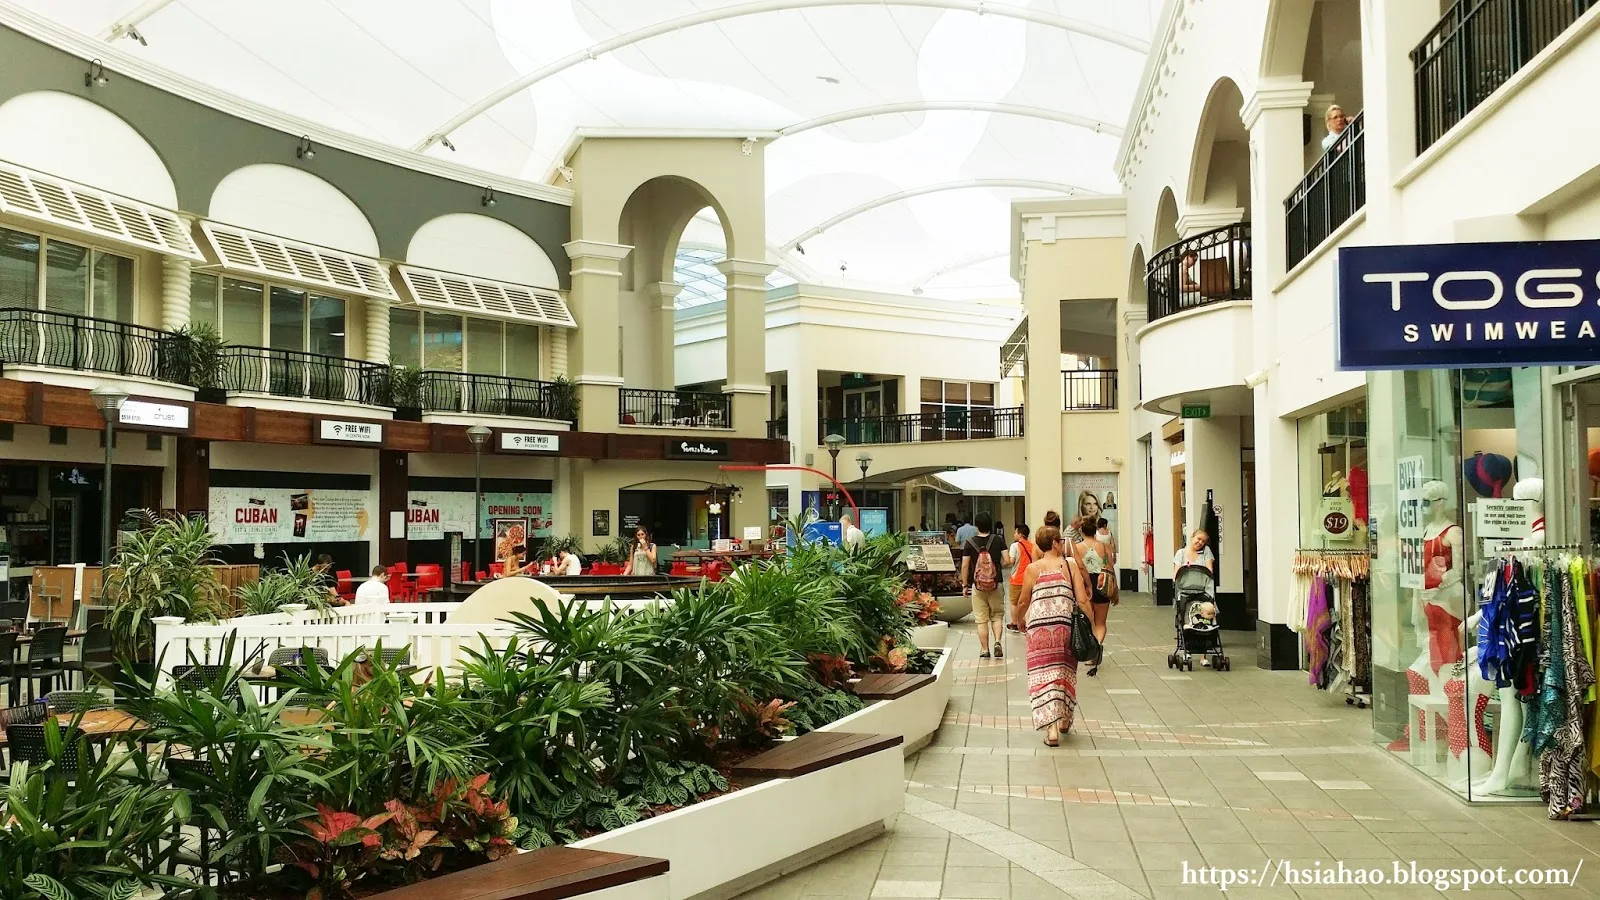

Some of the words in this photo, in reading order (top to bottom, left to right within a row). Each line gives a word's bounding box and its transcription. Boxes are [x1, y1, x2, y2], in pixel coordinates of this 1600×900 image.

[1363, 269, 1600, 311] TOG
[1404, 321, 1596, 343] SWIMWEA
[154, 413, 175, 421] crust
[1184, 407, 1201, 417] EXIT
[345, 424, 358, 433] FREE
[359, 425, 371, 434] WIFI
[524, 435, 536, 443] FREE
[537, 436, 549, 444] WIFI
[1399, 461, 1416, 490] BUY
[235, 508, 278, 523] CUBAN
[488, 505, 520, 515] OPENING
[522, 505, 542, 515] SOON
[1400, 499, 1418, 528] GET
[1325, 516, 1348, 530] $19
